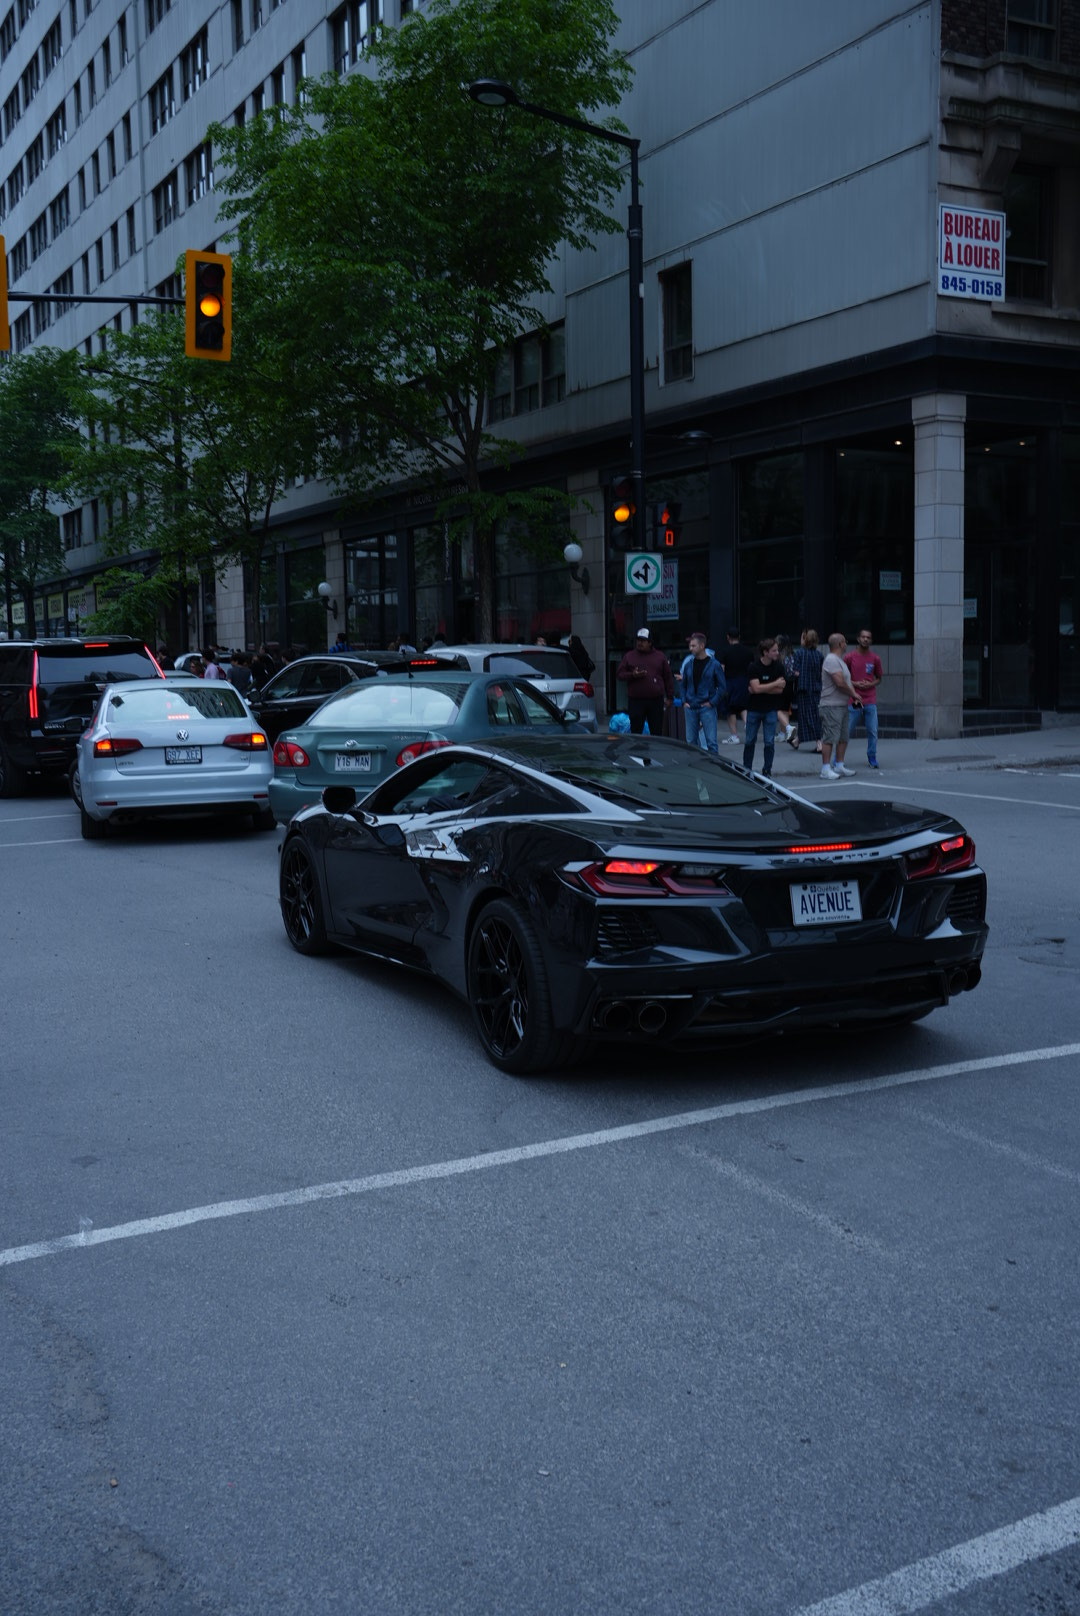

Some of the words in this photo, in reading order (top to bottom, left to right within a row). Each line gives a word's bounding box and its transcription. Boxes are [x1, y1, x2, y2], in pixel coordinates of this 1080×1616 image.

[944, 212, 1000, 242] BUREAU
[944, 236, 953, 264] À
[957, 243, 1000, 270] LOUER
[942, 275, 1002, 296] 845-0158
[801, 891, 854, 914] AVENUE
